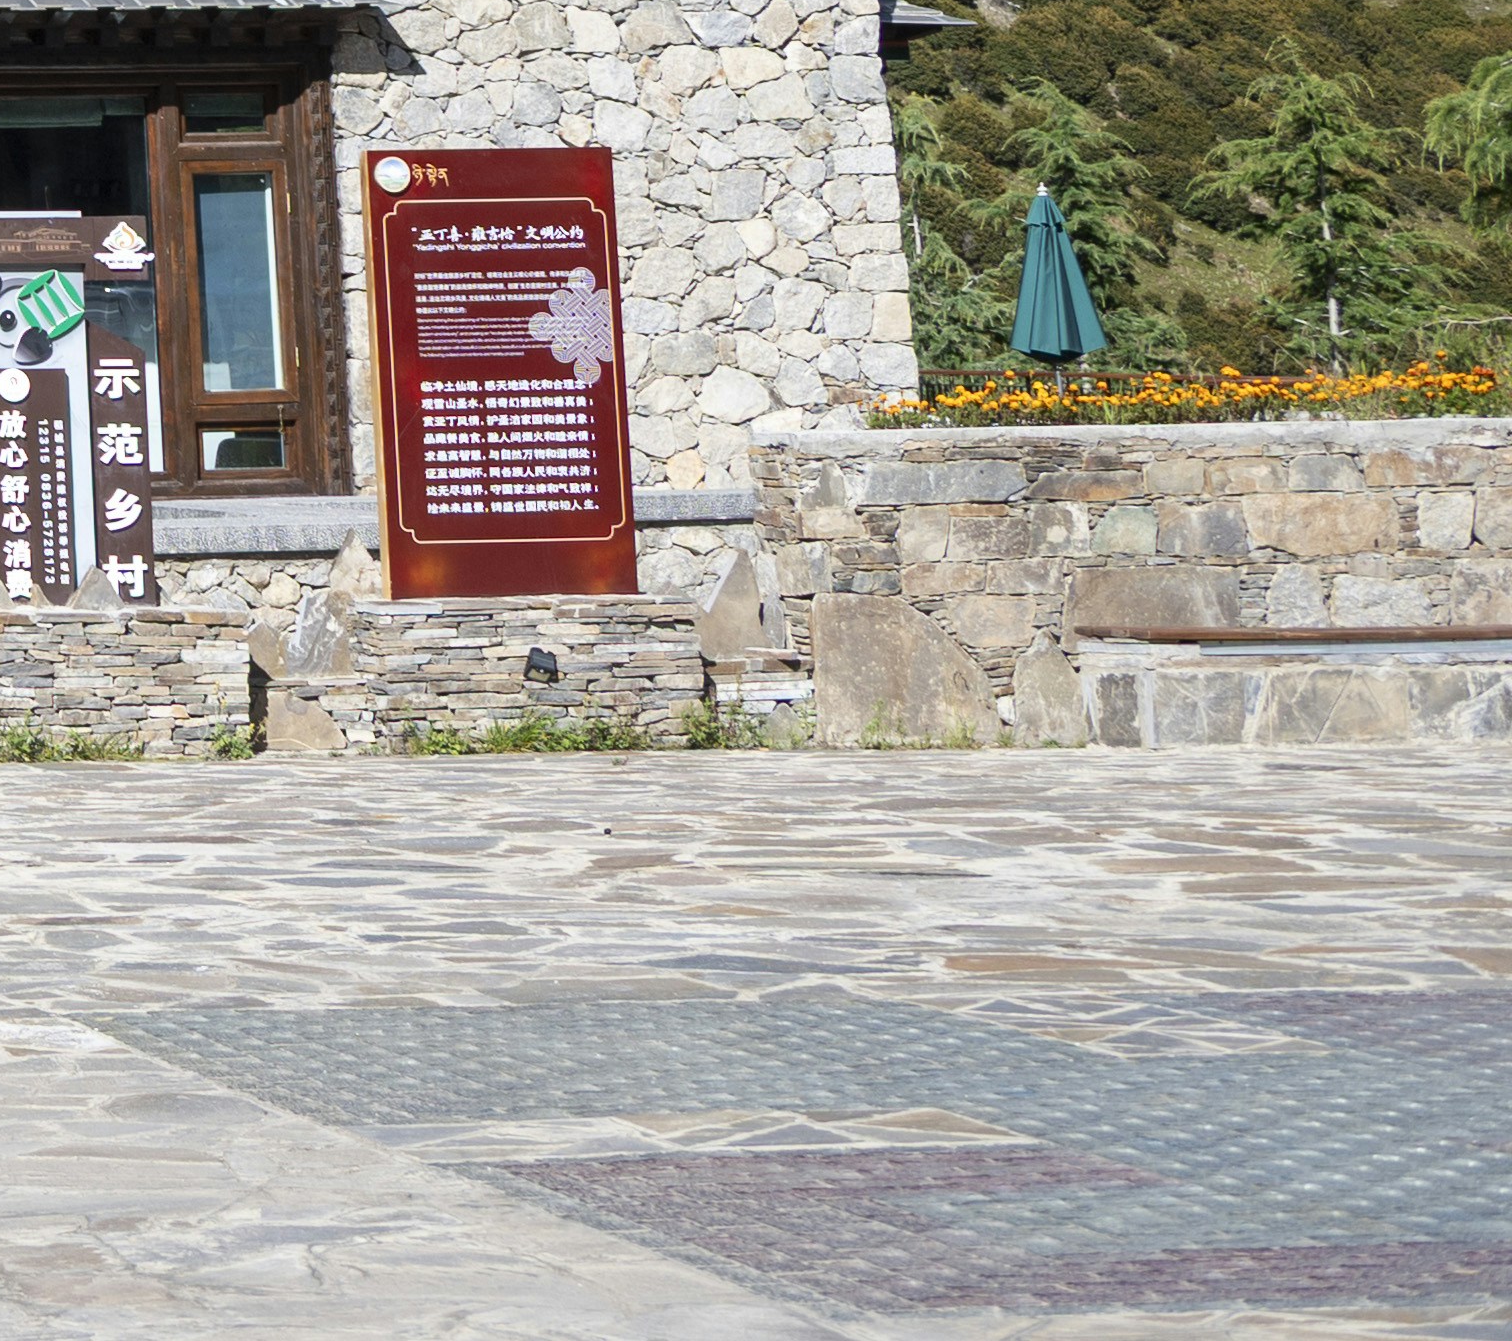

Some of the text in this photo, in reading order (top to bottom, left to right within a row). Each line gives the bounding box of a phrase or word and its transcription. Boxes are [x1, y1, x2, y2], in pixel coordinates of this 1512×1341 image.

[37, 418, 51, 464] 12315
[93, 358, 149, 599] 示范乡村
